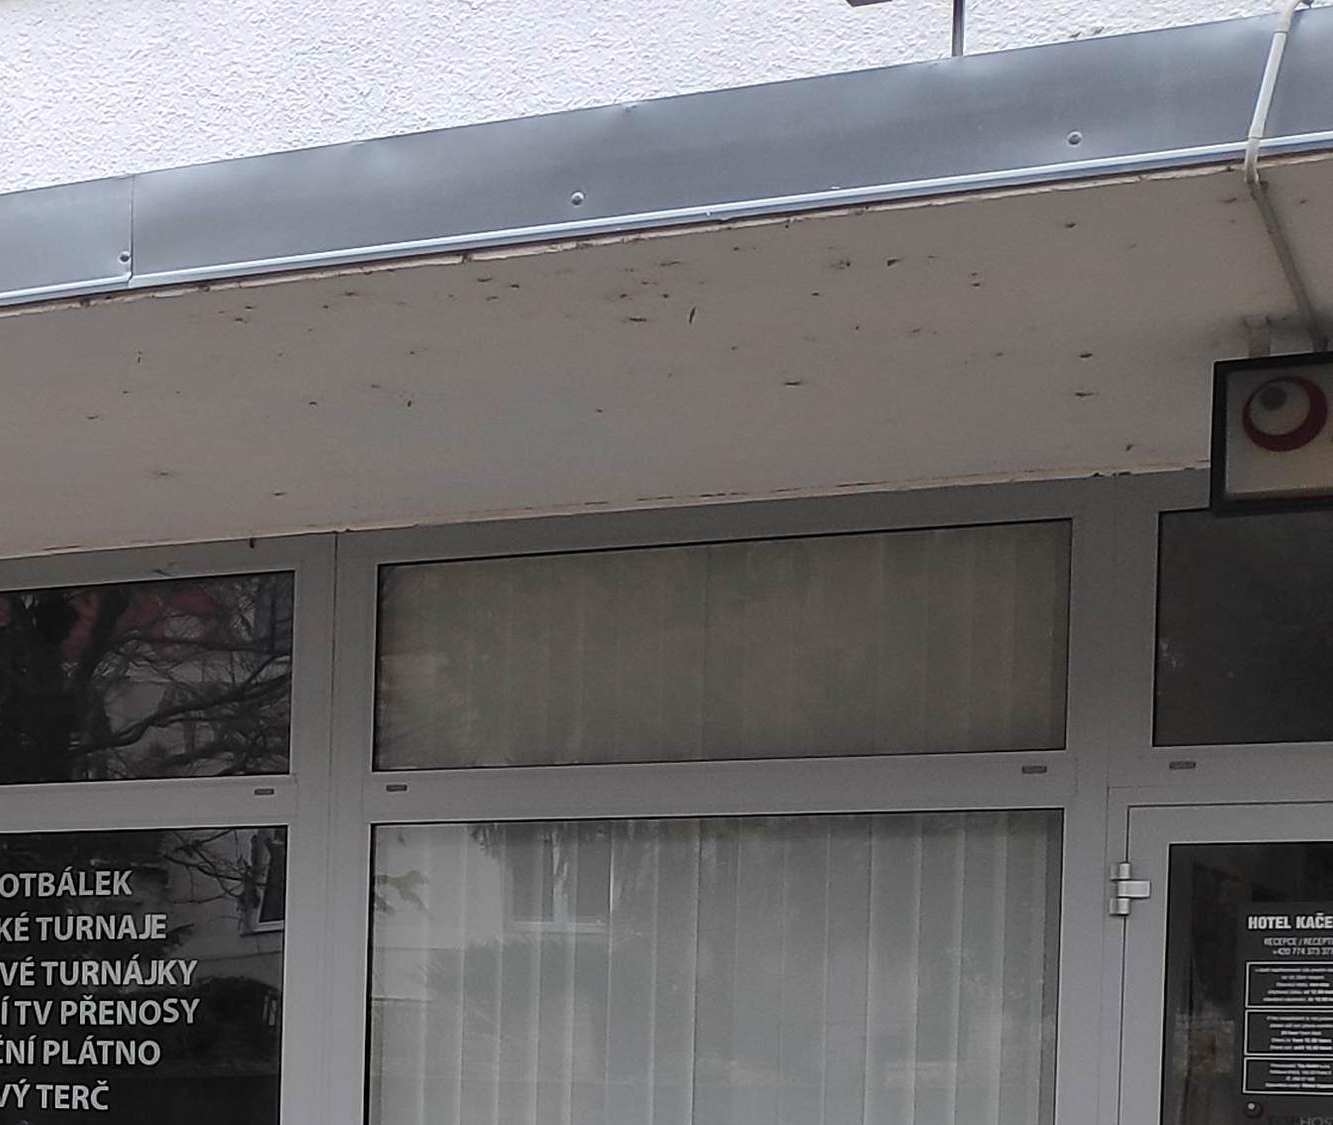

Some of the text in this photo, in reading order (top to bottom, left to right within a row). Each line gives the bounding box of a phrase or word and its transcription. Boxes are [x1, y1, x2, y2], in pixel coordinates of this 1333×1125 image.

[35, 914, 168, 942] TURNAJE
[1248, 912, 1333, 930] HOTEL KAČE
[41, 954, 198, 986] TURNÁJKY
[14, 1000, 53, 1025] TV
[60, 995, 201, 1026] PŘENOSY
[43, 1035, 162, 1066] PLÁTNO
[36, 1080, 110, 1111] TERČ
